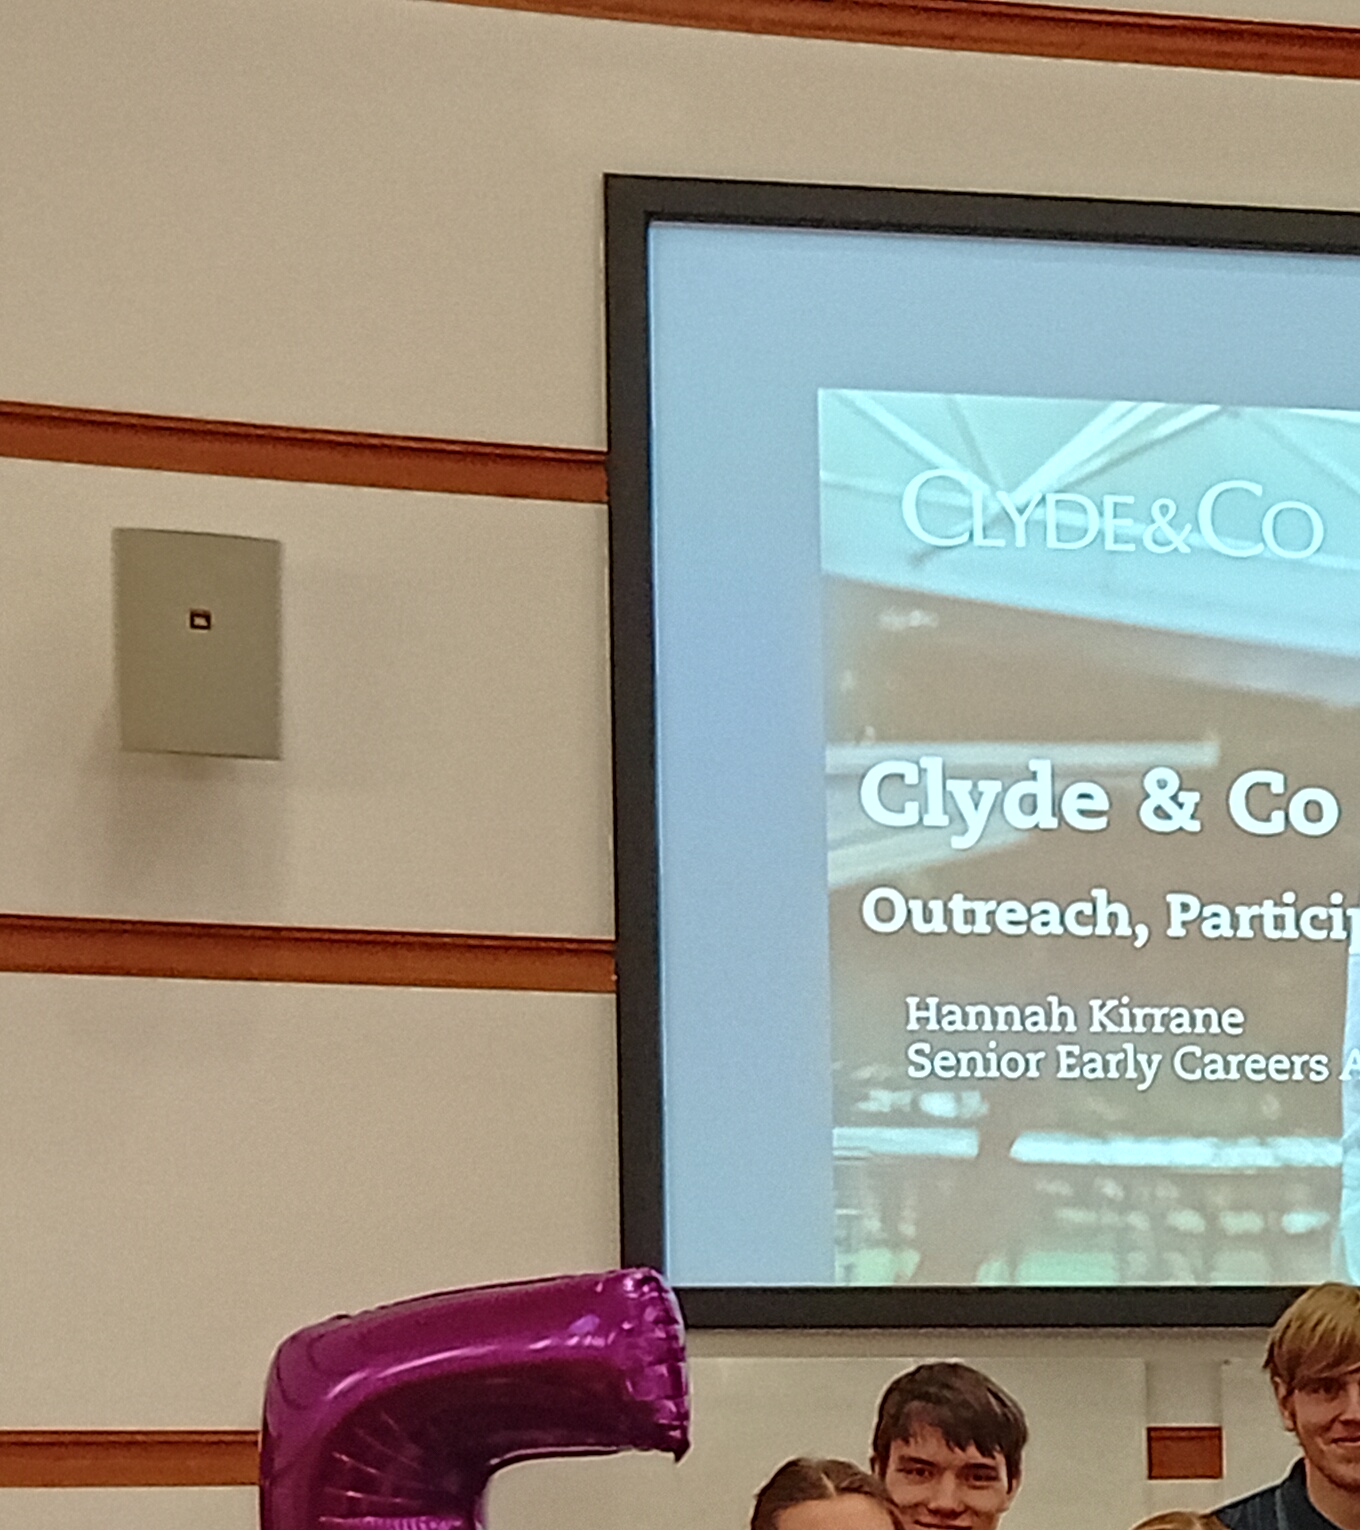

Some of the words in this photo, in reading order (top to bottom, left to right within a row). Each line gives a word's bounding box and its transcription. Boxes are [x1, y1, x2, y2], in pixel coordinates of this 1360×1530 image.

[860, 756, 1110, 849] Clyde
[1139, 766, 1202, 833] &
[1228, 769, 1340, 836] Co
[861, 886, 1151, 948] Outreach,
[906, 995, 1077, 1033] Hannah
[1090, 996, 1245, 1035] Kirrane
[907, 1041, 1046, 1079] Senior
[1056, 1043, 1163, 1091] Early
[1173, 1046, 1330, 1083] Careers
